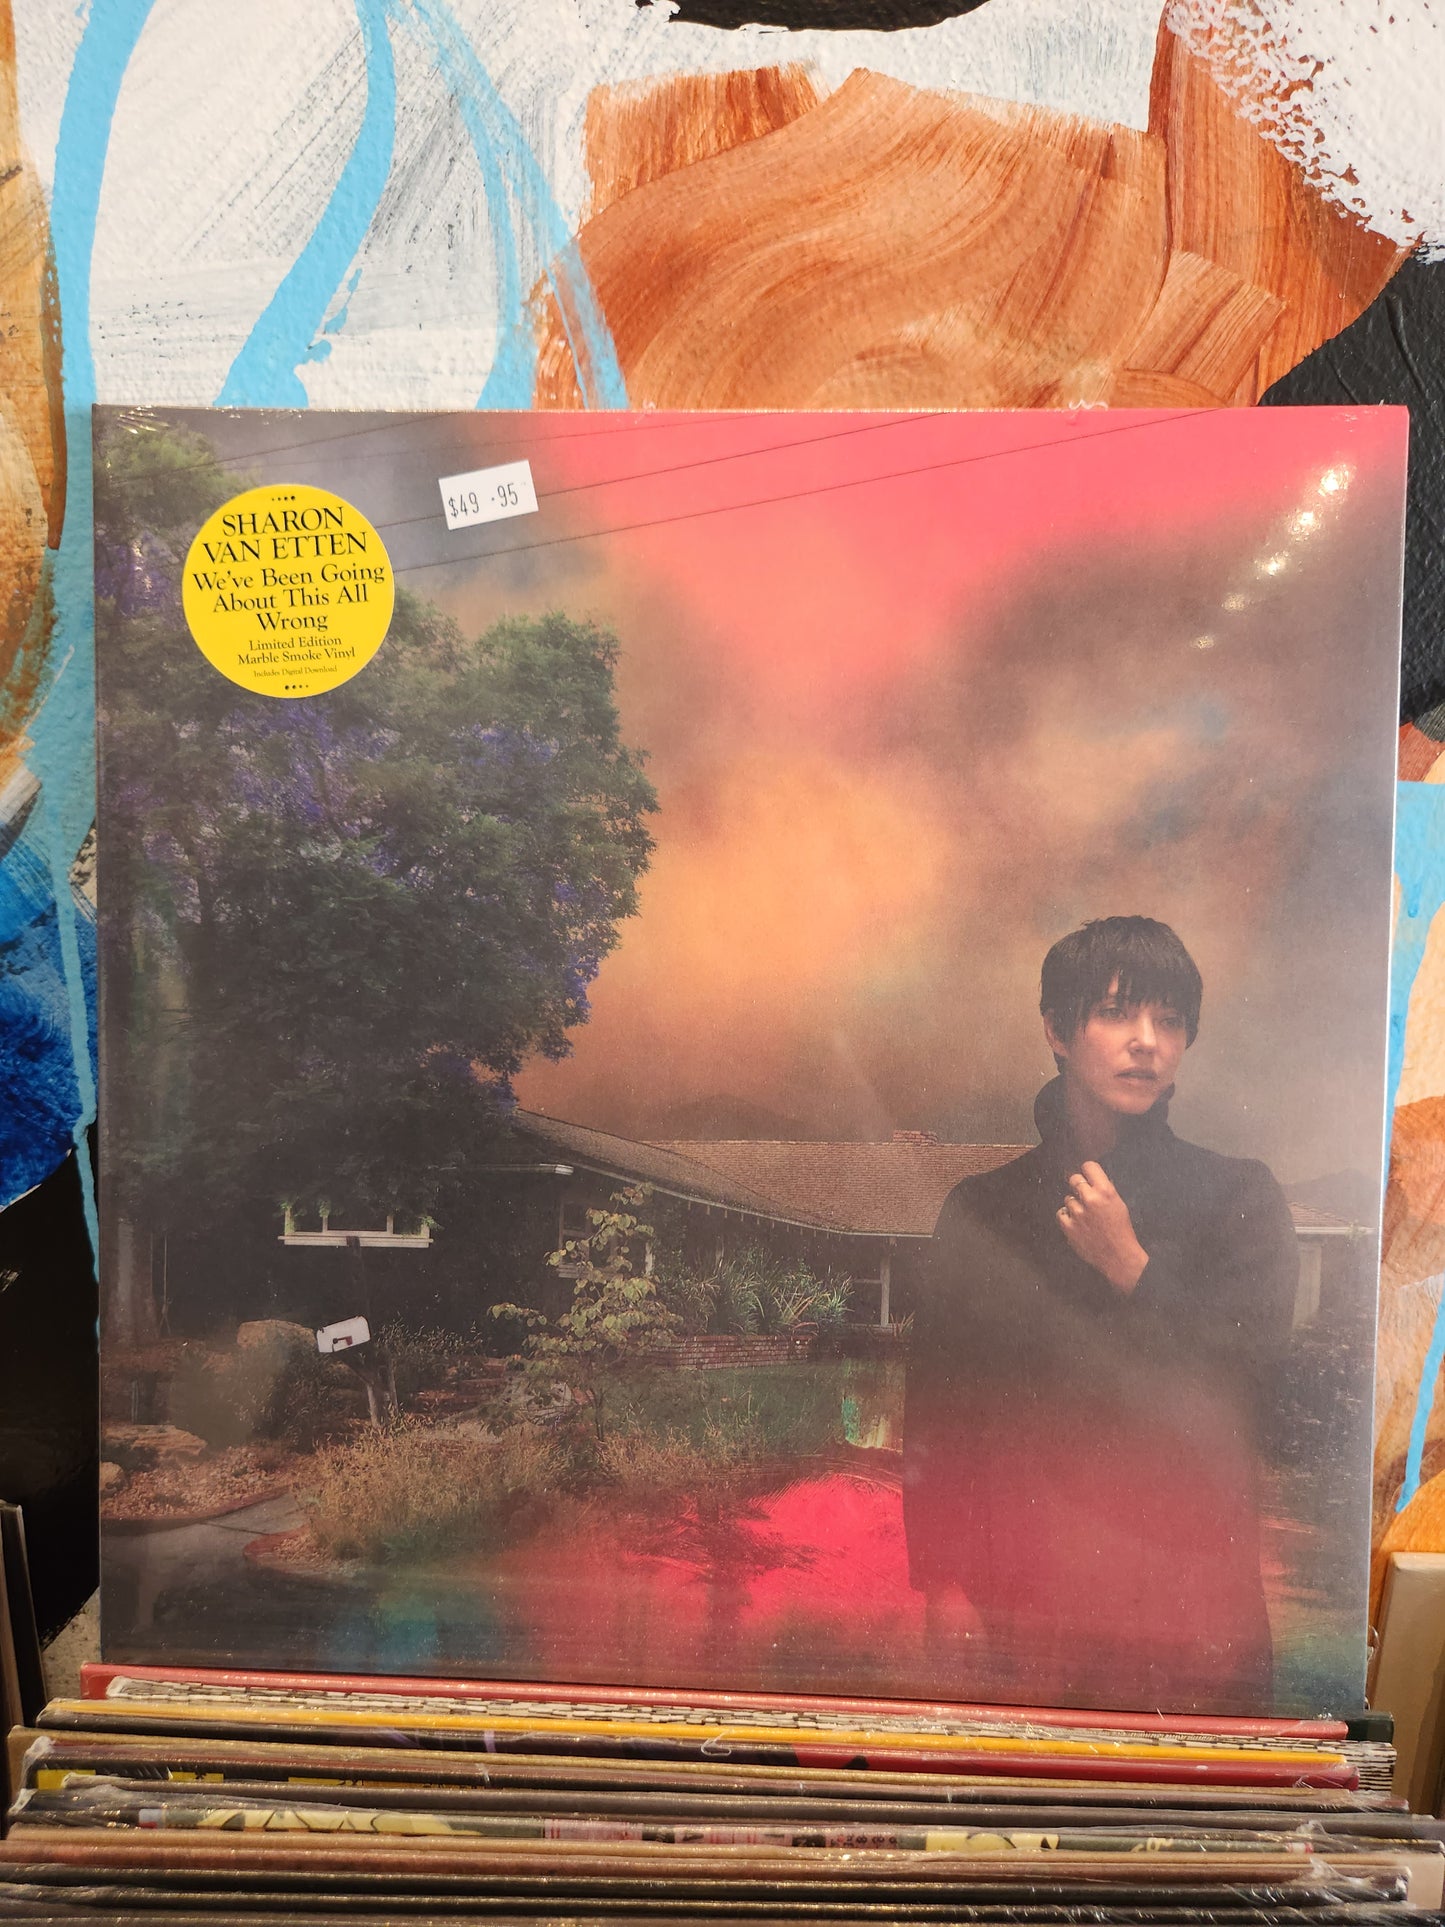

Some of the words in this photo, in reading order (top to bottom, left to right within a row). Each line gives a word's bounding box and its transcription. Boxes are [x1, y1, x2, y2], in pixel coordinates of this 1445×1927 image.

[222, 506, 344, 536] SHARON
[202, 540, 260, 564] VAN
[272, 531, 368, 560] ETTEN
[193, 570, 253, 591] We've
[262, 567, 313, 587] Been
[321, 562, 386, 584] Going
[213, 591, 277, 613] About
[283, 587, 330, 608] This
[337, 583, 368, 604] All
[256, 611, 328, 632] Wrong
[238, 652, 280, 665] Marble
[282, 650, 322, 662] Smoke
[325, 647, 355, 660] Vinyl
[249, 638, 295, 651] Limited
[298, 636, 342, 648] Edition
[253, 669, 280, 678] Includes
[282, 667, 304, 677] Digital
[305, 664, 338, 674] Download
